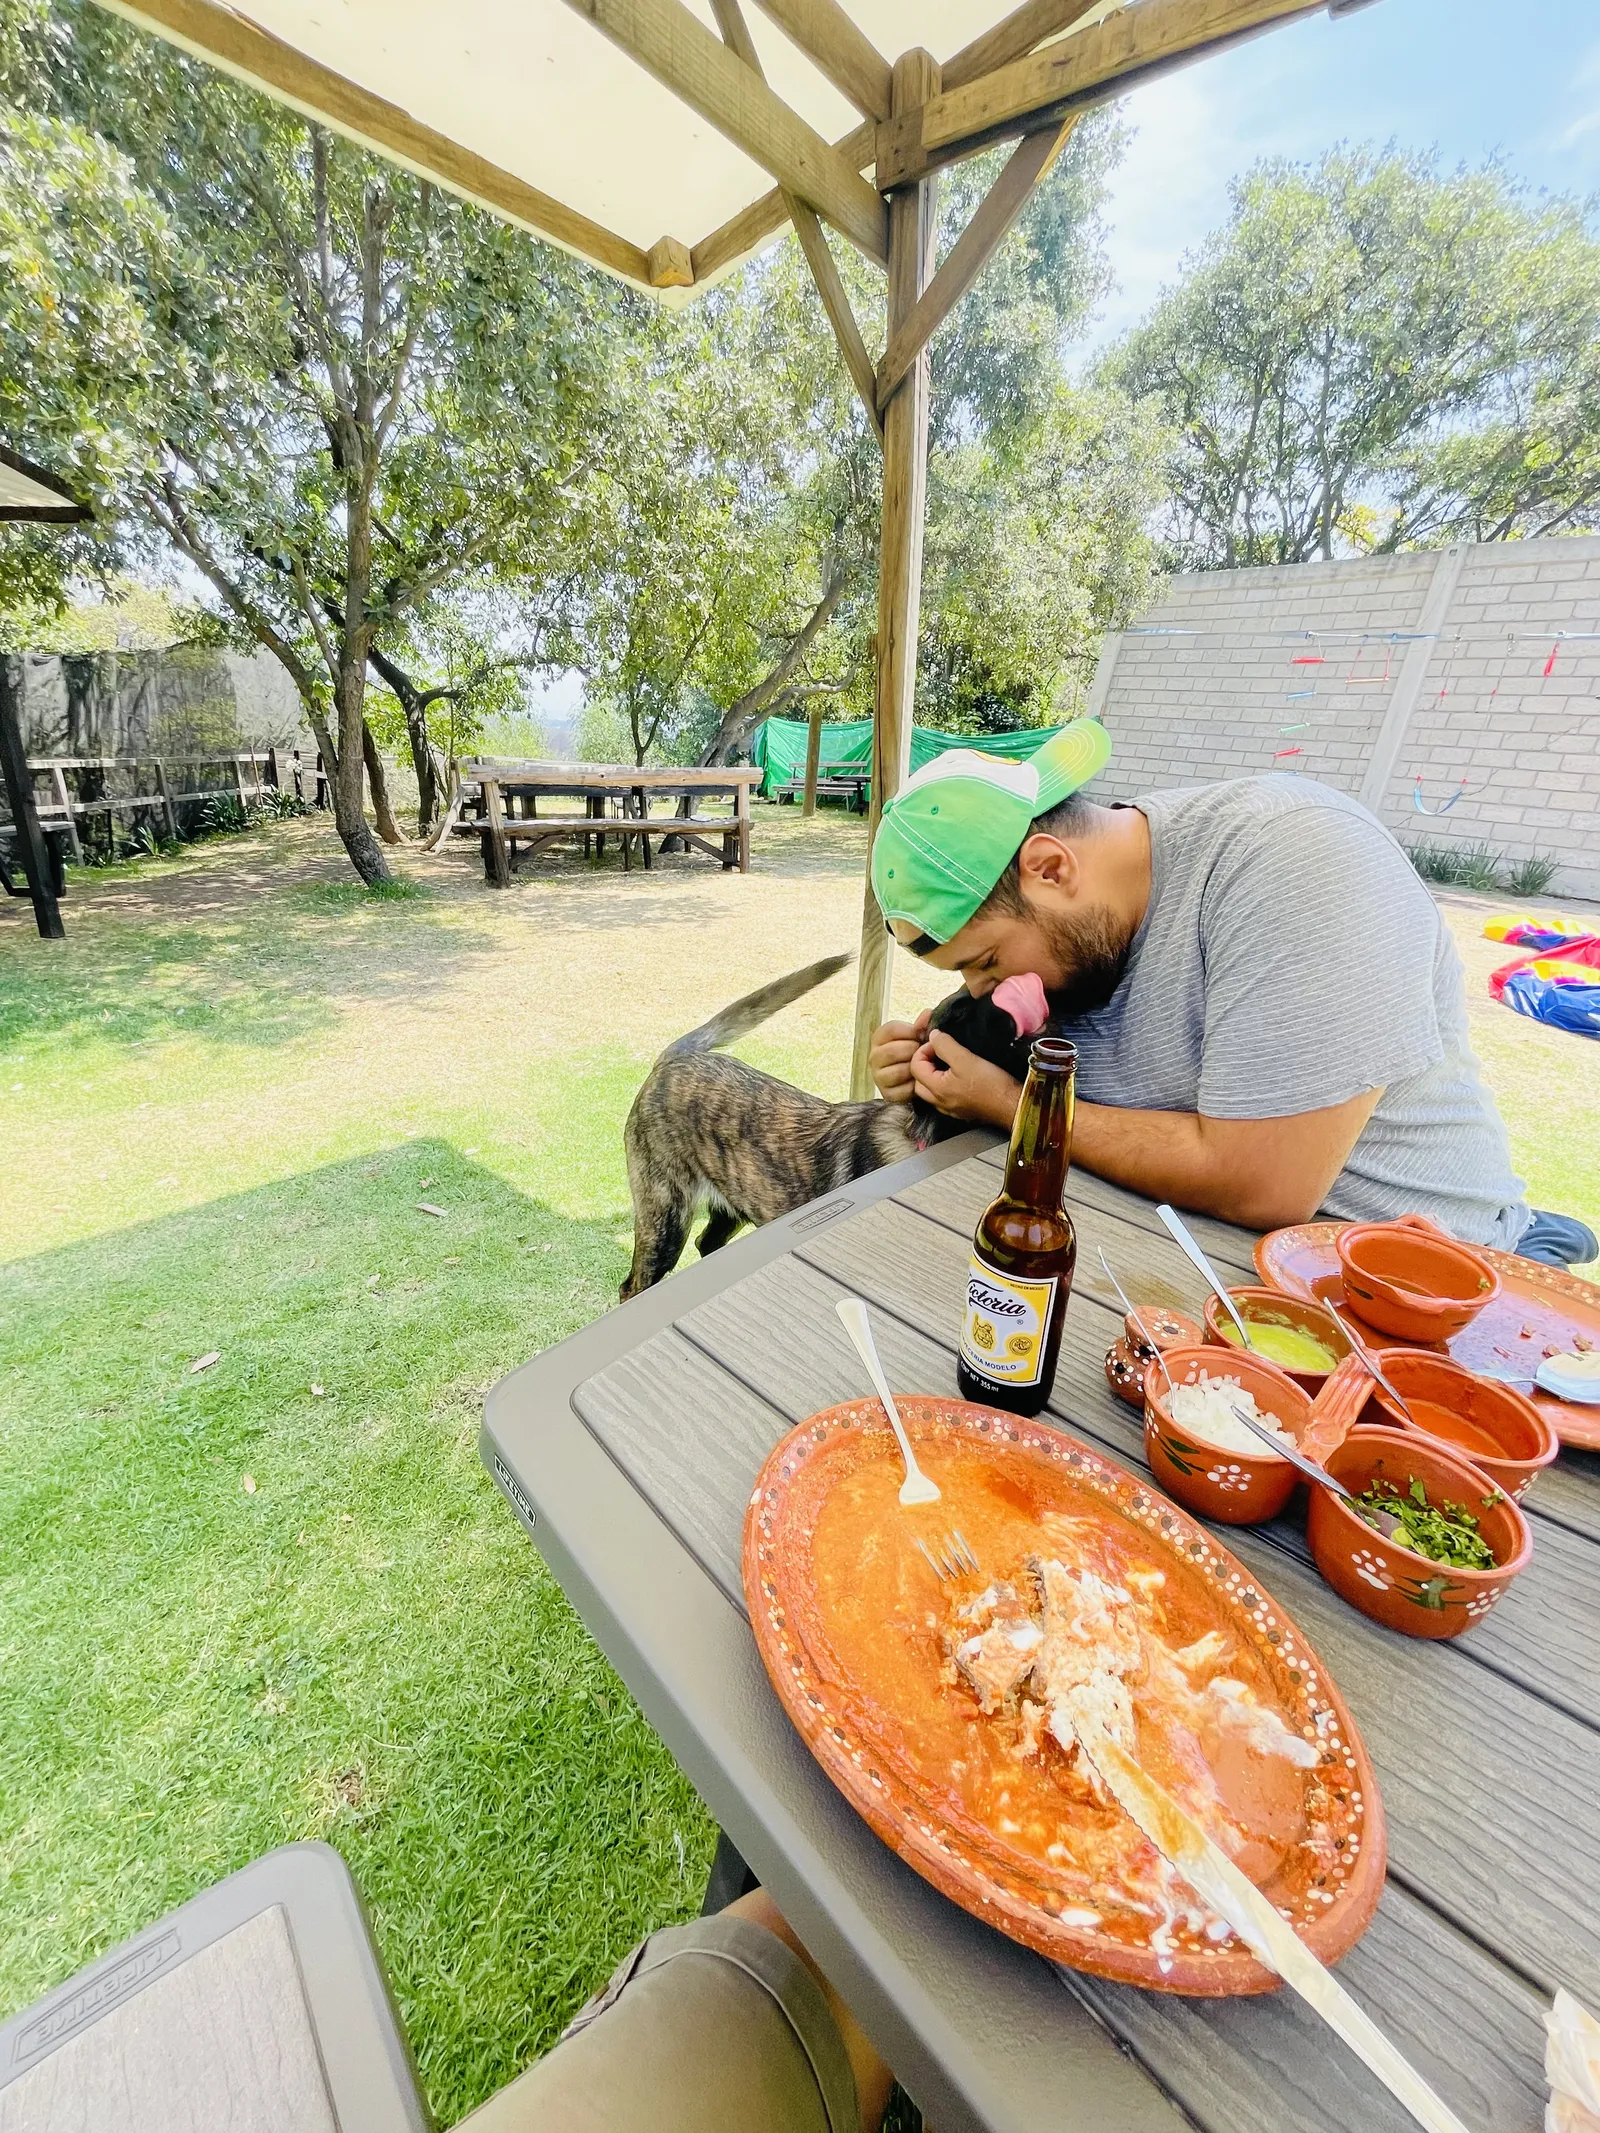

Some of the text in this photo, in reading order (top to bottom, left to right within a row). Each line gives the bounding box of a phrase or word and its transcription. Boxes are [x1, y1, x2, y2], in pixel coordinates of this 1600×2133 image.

[984, 1361, 1017, 1371] MODELO
[980, 1379, 991, 1390] 355
[35, 1946, 164, 2044] LIFETIME
